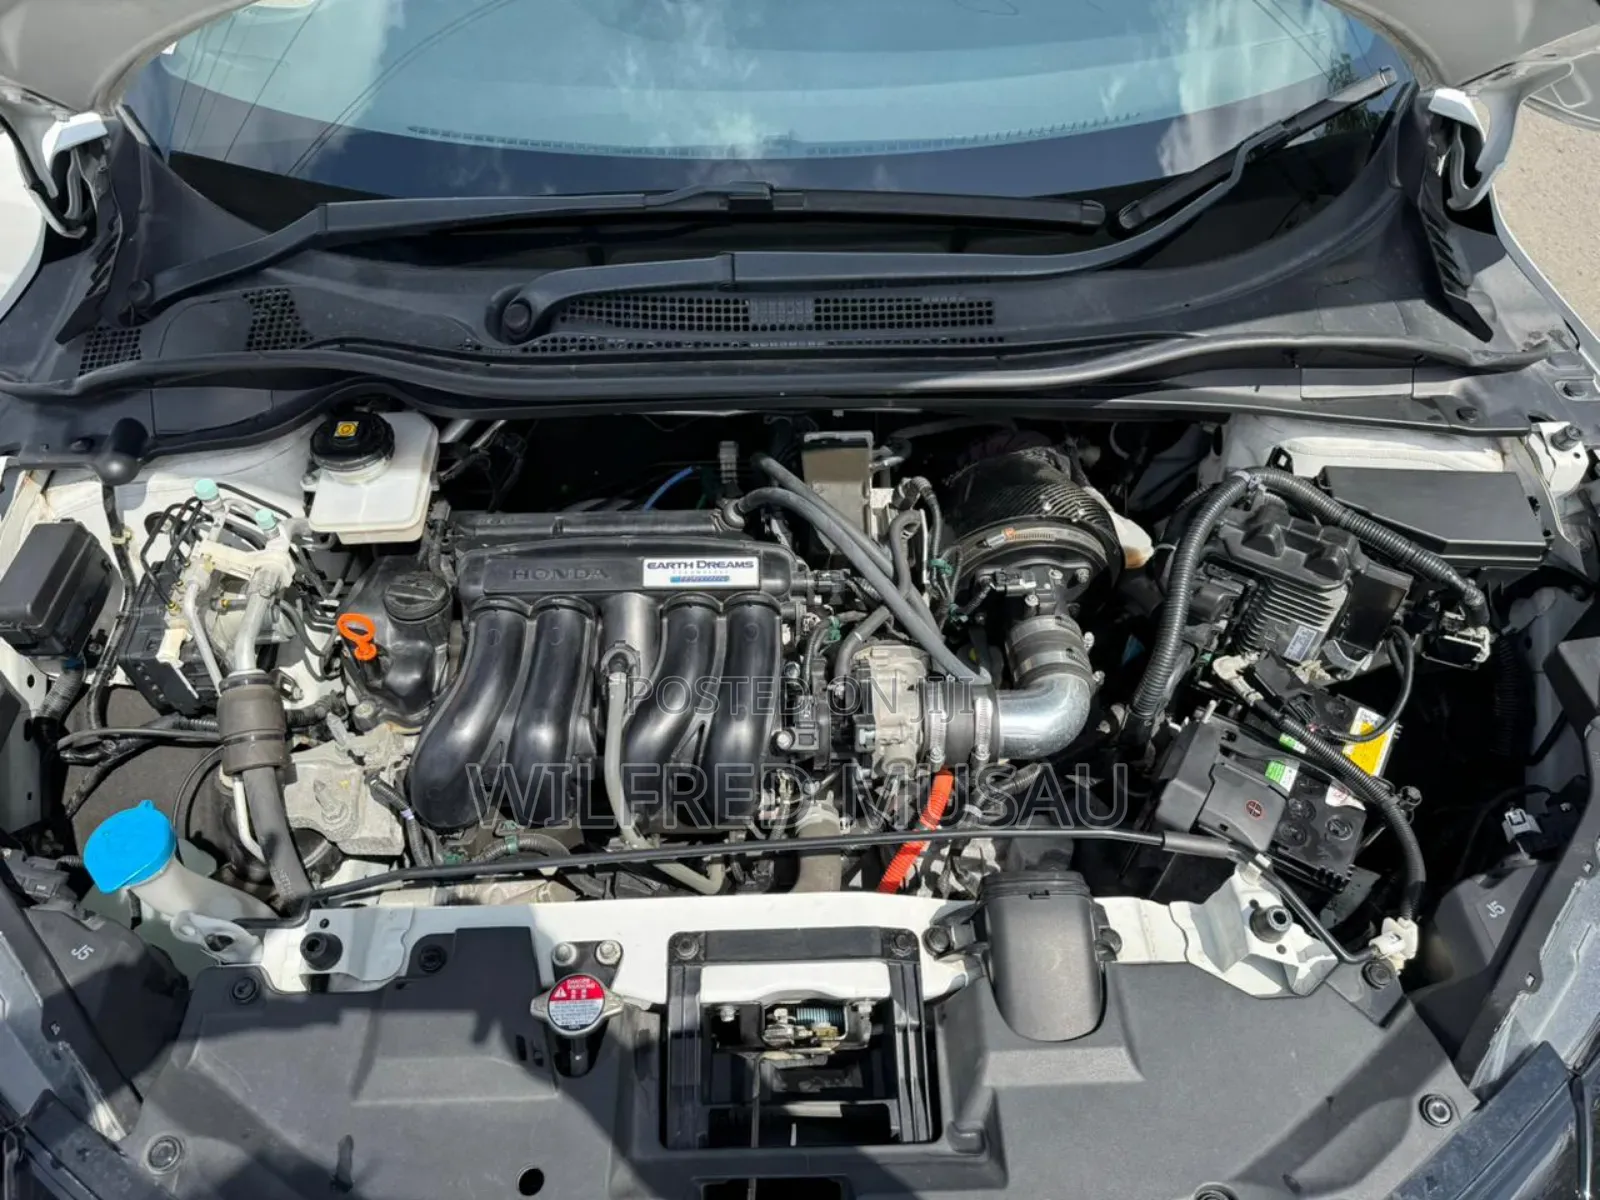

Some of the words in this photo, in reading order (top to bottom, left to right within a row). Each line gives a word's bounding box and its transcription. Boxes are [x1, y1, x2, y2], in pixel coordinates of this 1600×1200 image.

[647, 561, 694, 570] EARTH
[696, 560, 754, 569] DREAMS
[510, 567, 612, 582] HONDA
